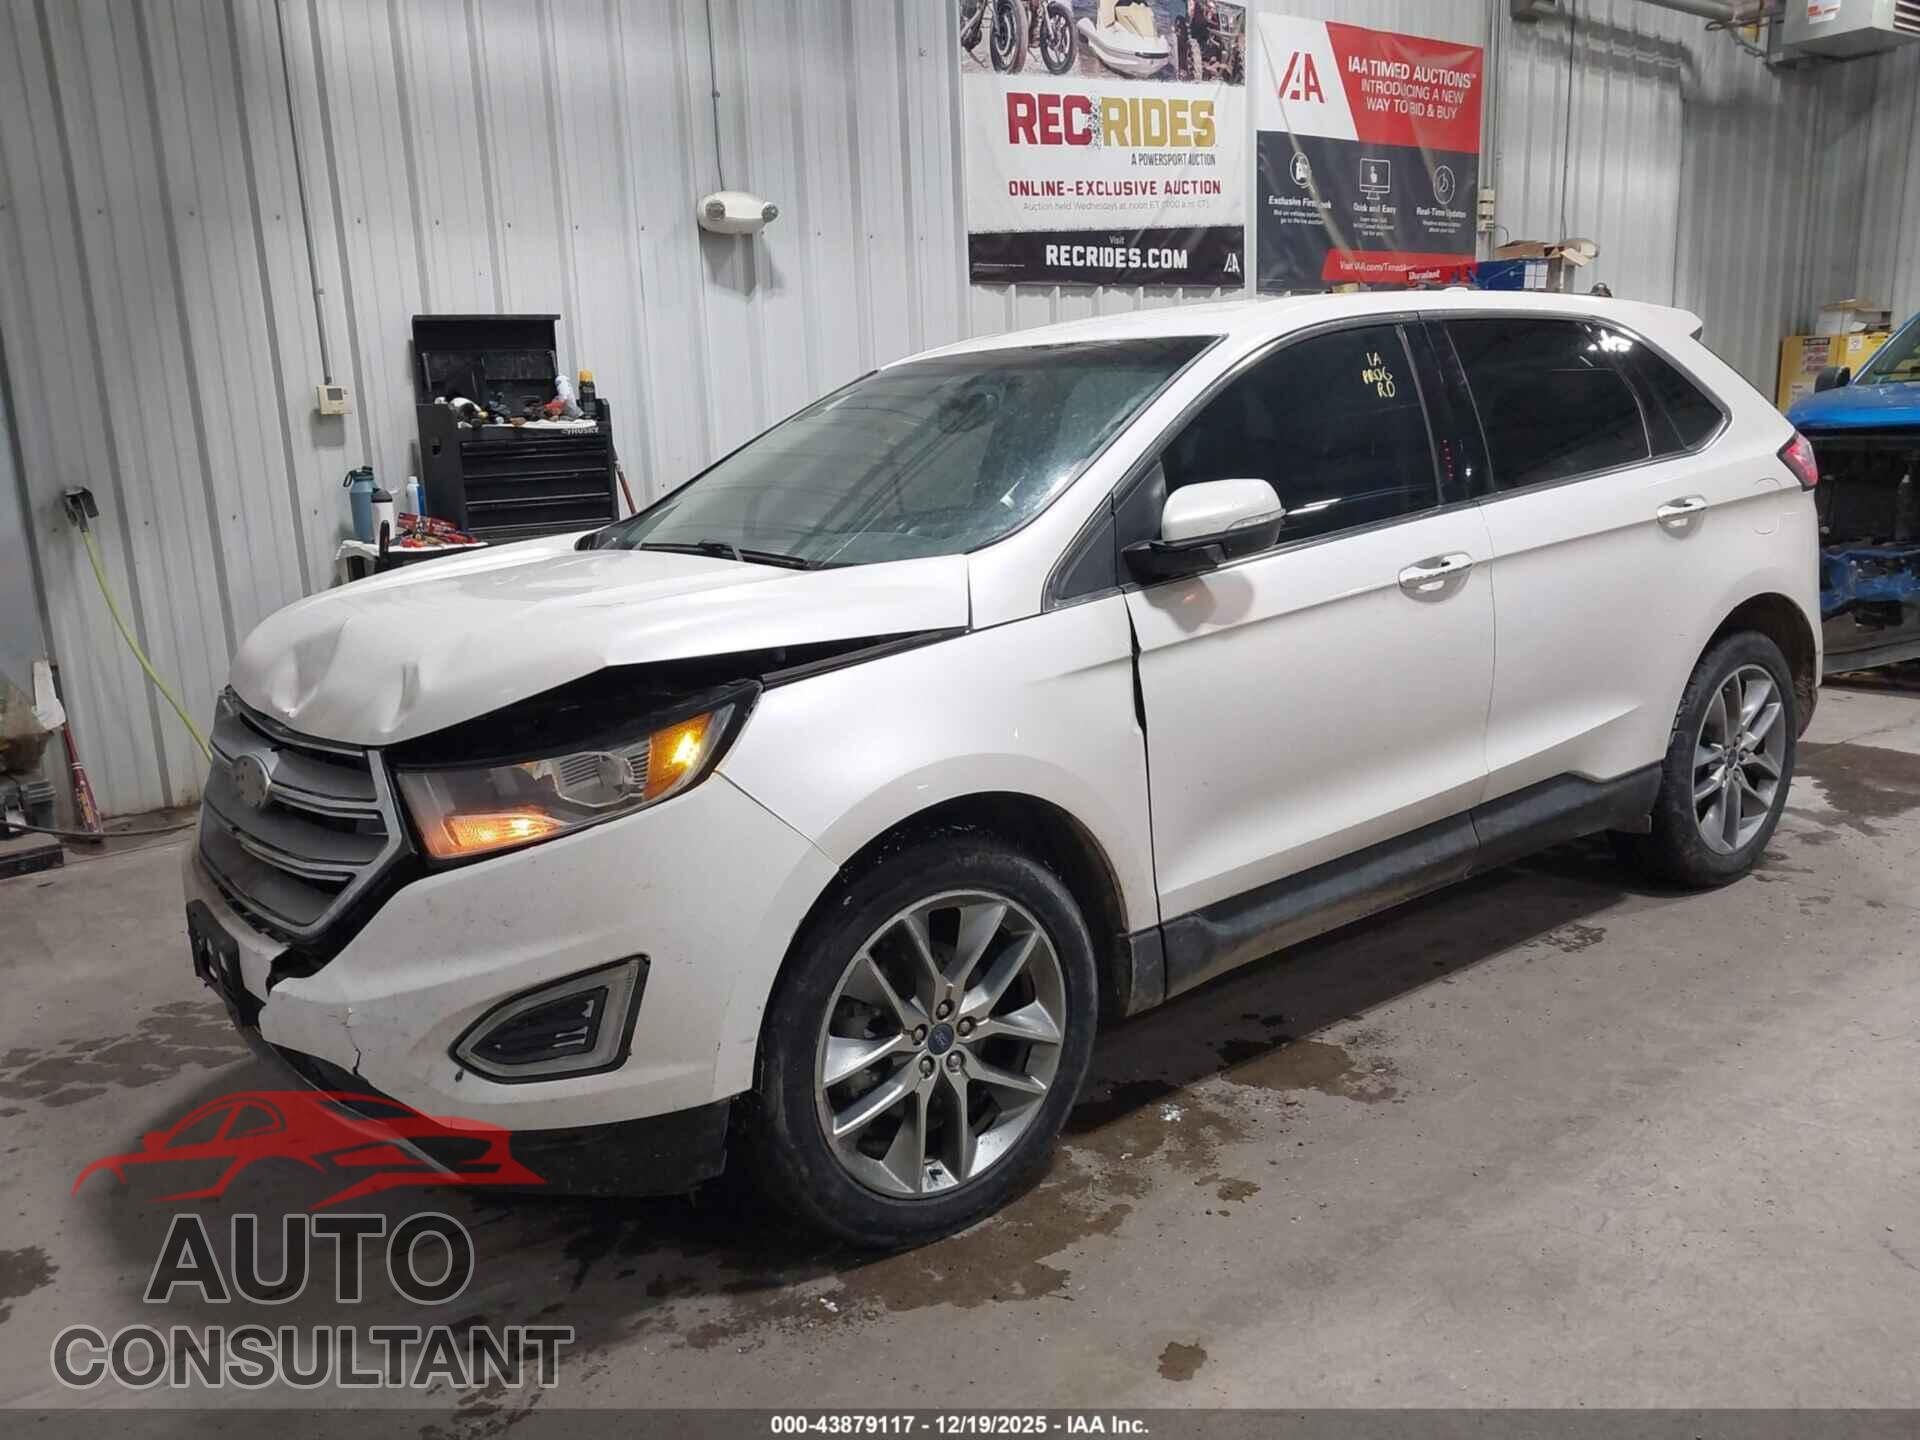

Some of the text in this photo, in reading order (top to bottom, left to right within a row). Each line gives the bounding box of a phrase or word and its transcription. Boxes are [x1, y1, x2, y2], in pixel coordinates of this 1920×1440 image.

[1348, 56, 1369, 75] IAA
[1368, 60, 1410, 80] TIMED
[1361, 79, 1465, 105] INTRODUCING A NEW
[1366, 96, 1458, 119] WAY TO BID & BUY
[1006, 92, 1216, 147] REC RIDES
[1131, 152, 1216, 167] A POWERSPORT AUCTION
[1009, 180, 1221, 197] ONLINE-EXCLUSIVE AUCTION
[1109, 235, 1125, 244] Visit
[1046, 245, 1188, 269] RECRIDES.COM
[1408, 269, 1440, 280] Duralast
